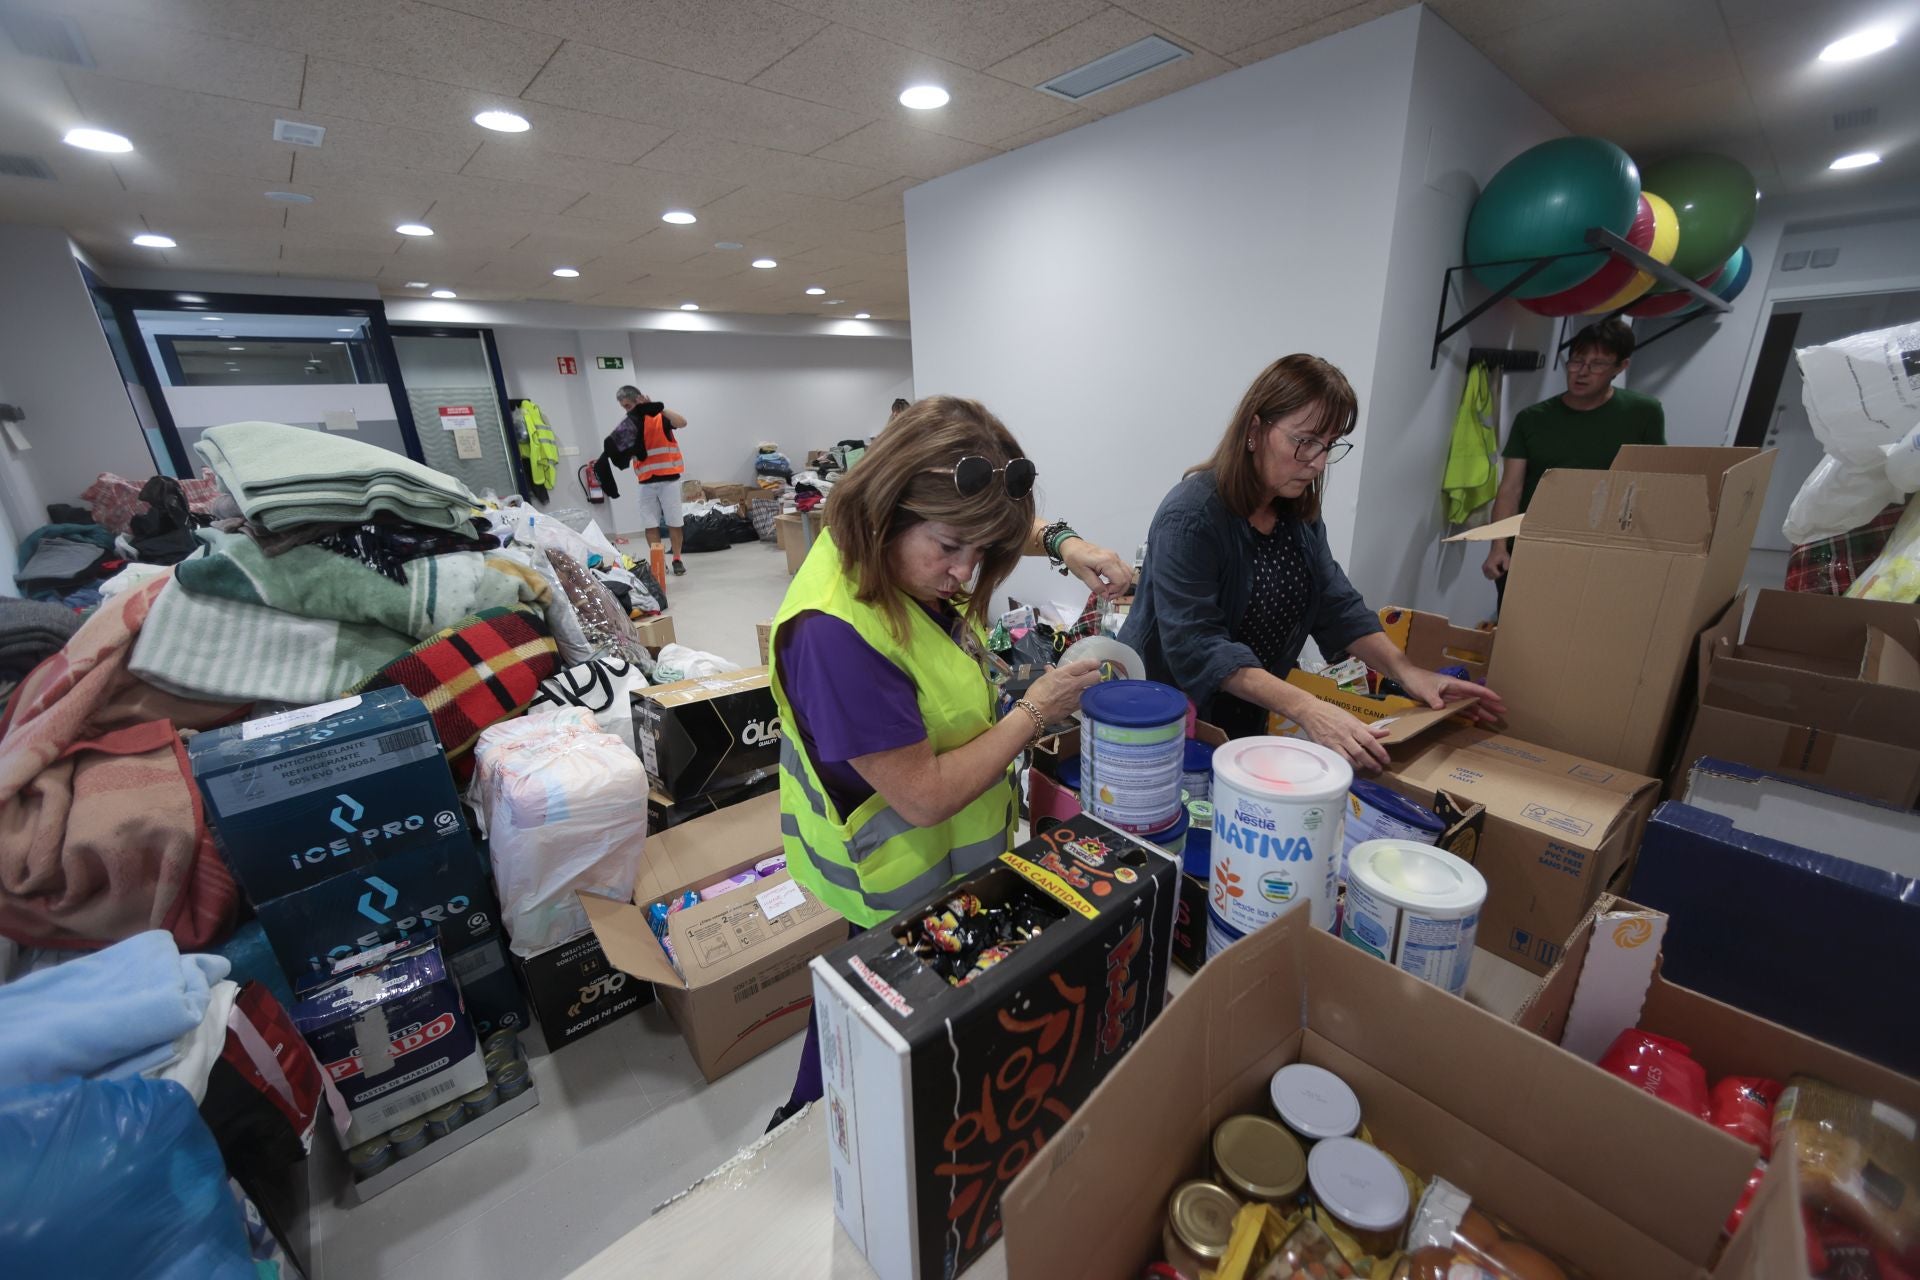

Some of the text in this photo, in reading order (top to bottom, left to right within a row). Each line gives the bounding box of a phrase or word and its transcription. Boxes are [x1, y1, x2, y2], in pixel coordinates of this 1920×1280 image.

[1352, 705, 1362, 713] DE
[272, 740, 367, 772] ANTICONGELANTE
[758, 738, 777, 747] QUALITY
[281, 752, 361, 779] REFRIGERANTE
[288, 773, 310, 787] 50%
[335, 763, 347, 773] 12
[348, 756, 377, 770] ROSA
[290, 838, 351, 870] ICE
[361, 815, 424, 846] PRO
[1214, 808, 1313, 862] NATIVA
[1548, 842, 1565, 854] PVC
[1544, 850, 1561, 860] PVC
[1004, 855, 1031, 873] MÁS
[1030, 871, 1092, 914] CANTIDAD
[1563, 866, 1581, 877] PVC
[1214, 884, 1224, 910] 2
[1232, 898, 1255, 914] Desde
[396, 895, 470, 938] PRO
[687, 930, 694, 938] 1
[578, 972, 626, 1003] ÖLQ
[565, 995, 637, 1036] MADE IN EUROPE
[330, 1021, 446, 1081] PADO
[357, 1058, 448, 1101] PASTIS DE MARSEILLE
[1644, 1065, 1663, 1096] ONES
